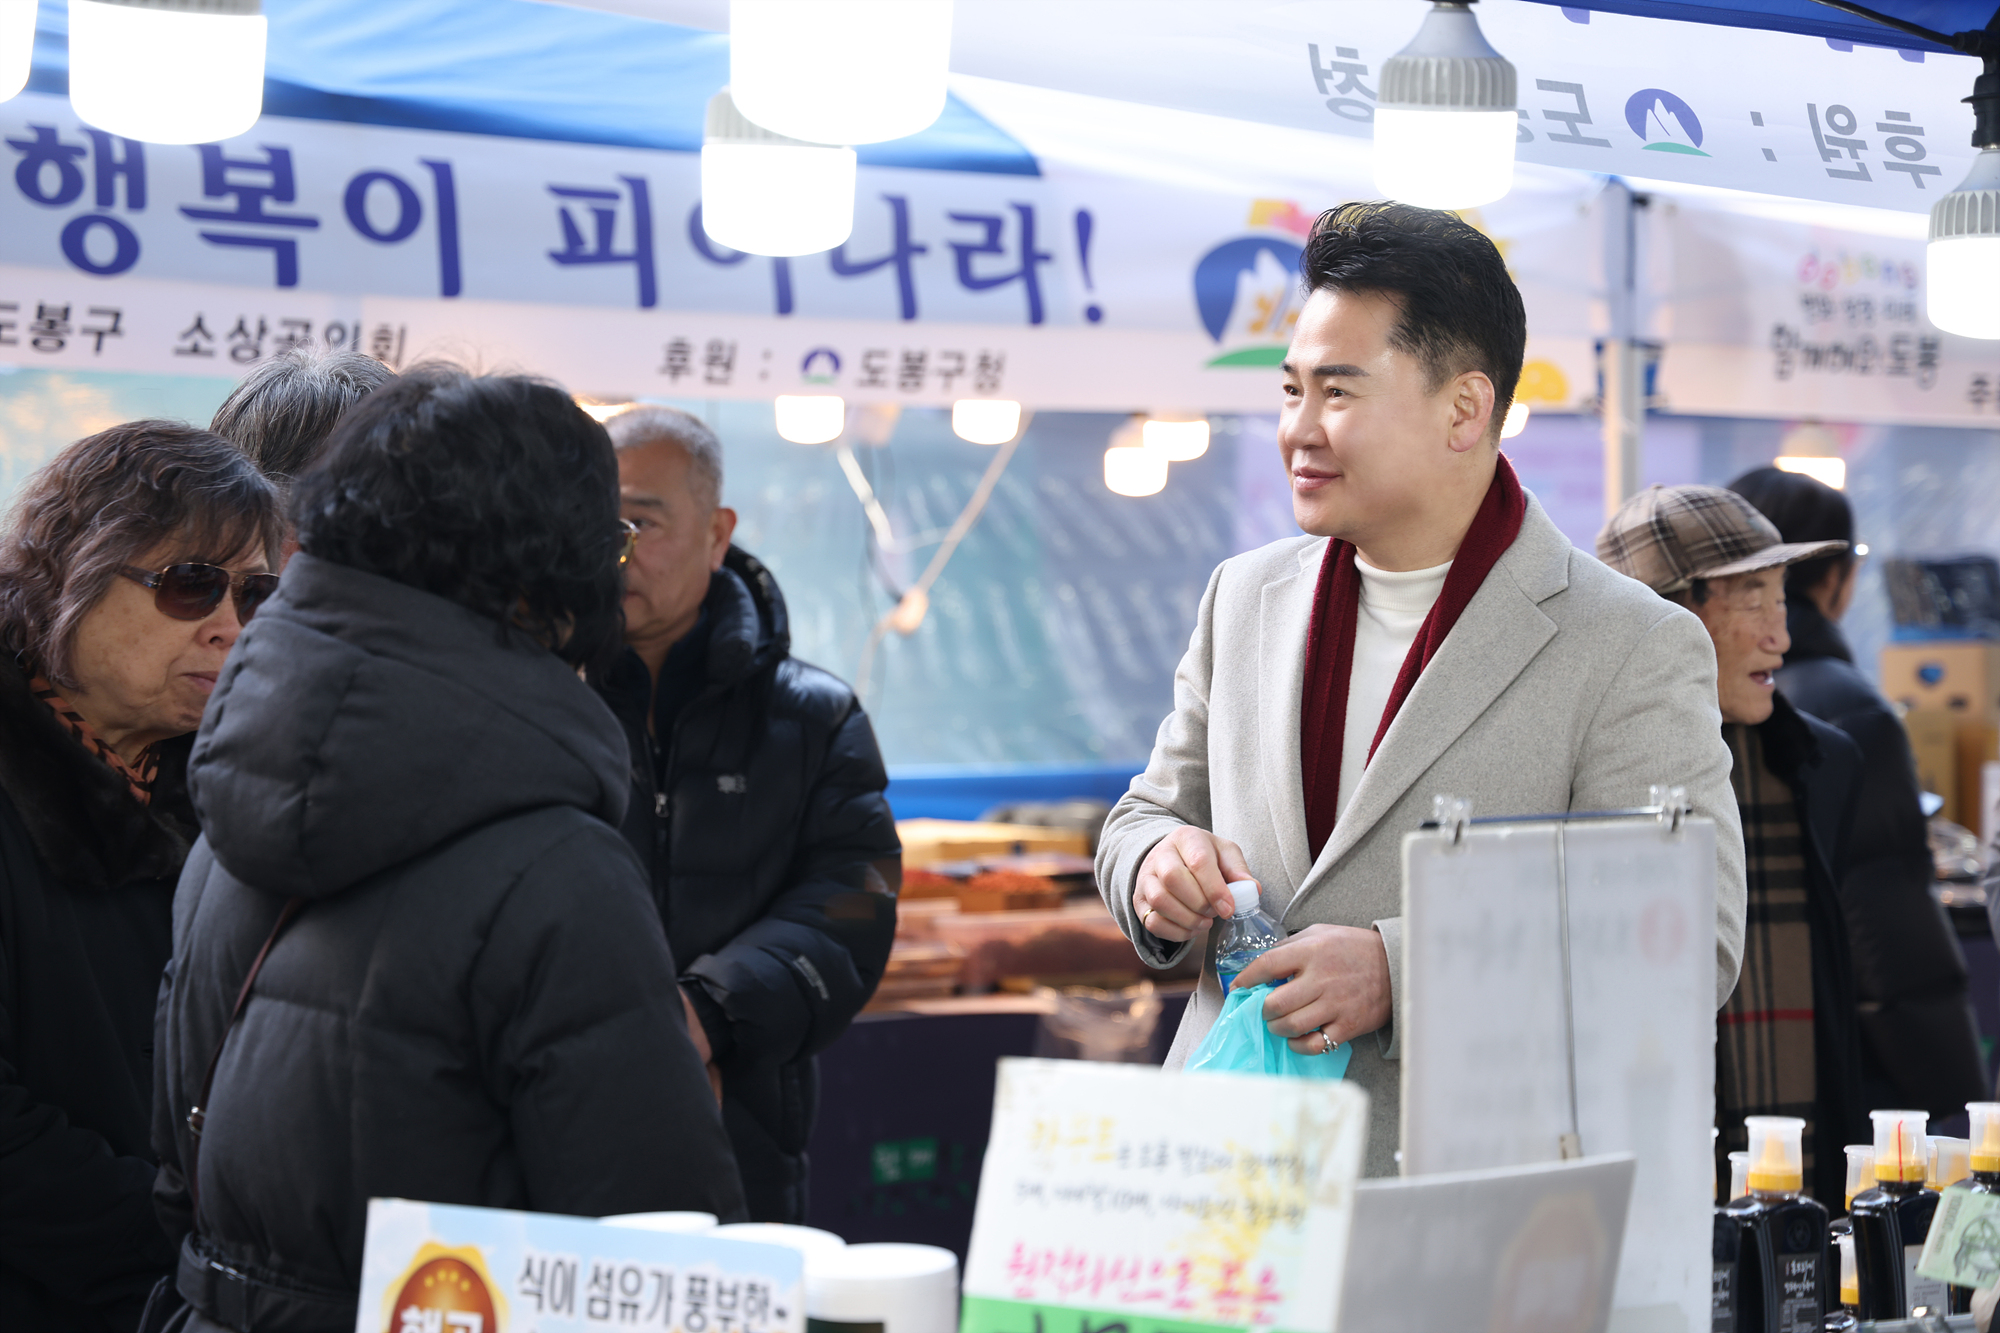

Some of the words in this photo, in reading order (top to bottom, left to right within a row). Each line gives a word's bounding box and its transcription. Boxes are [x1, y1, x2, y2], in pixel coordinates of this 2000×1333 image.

[5, 122, 463, 299] 행복이
[657, 334, 740, 387] 후원
[853, 346, 1007, 397] 도봉구청
[517, 1256, 577, 1315] 식이
[586, 1263, 675, 1327] 섬유가
